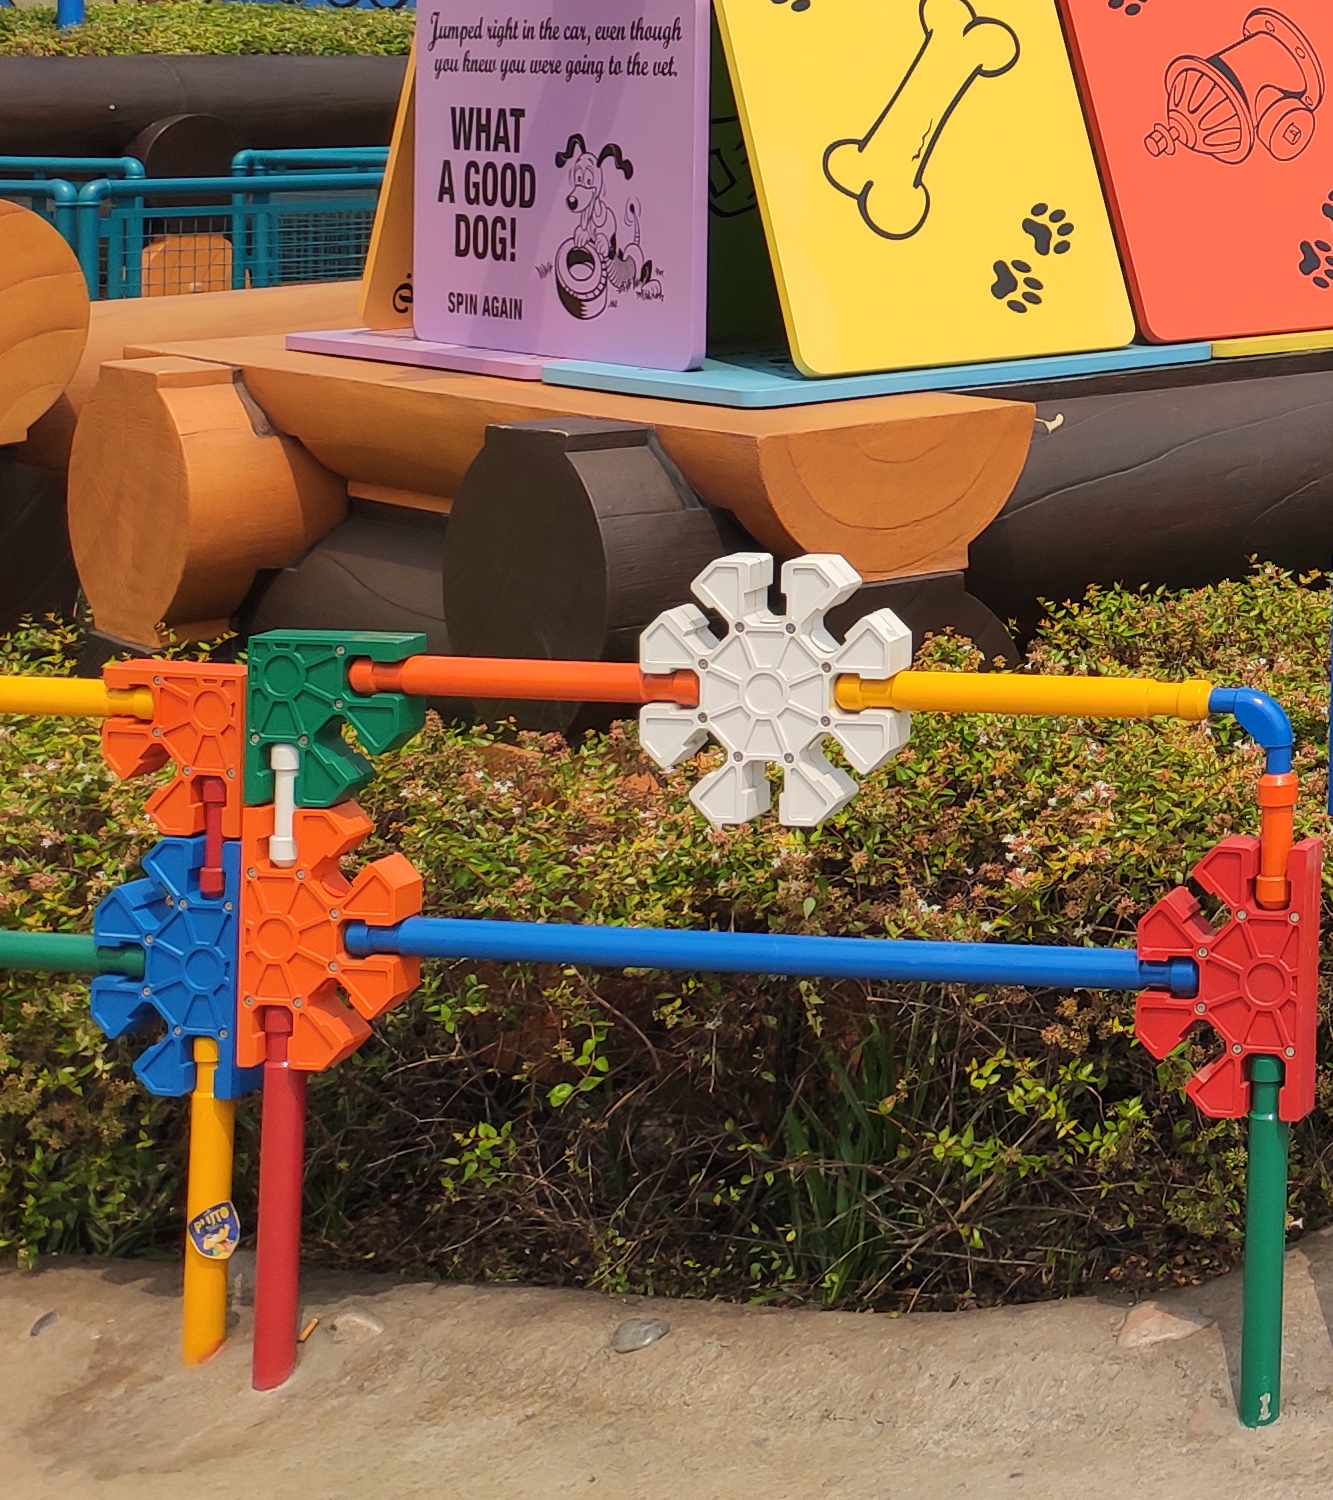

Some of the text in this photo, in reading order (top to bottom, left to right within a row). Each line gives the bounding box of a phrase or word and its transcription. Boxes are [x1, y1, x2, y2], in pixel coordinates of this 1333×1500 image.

[428, 11, 682, 51] Jumped right in the car, even though
[434, 50, 678, 83] you knew you were going to the vet.
[450, 106, 526, 153] WHAT
[437, 159, 536, 209] A GOOD
[454, 213, 517, 262] DOG!
[447, 292, 523, 320] SPIN AGAIN
